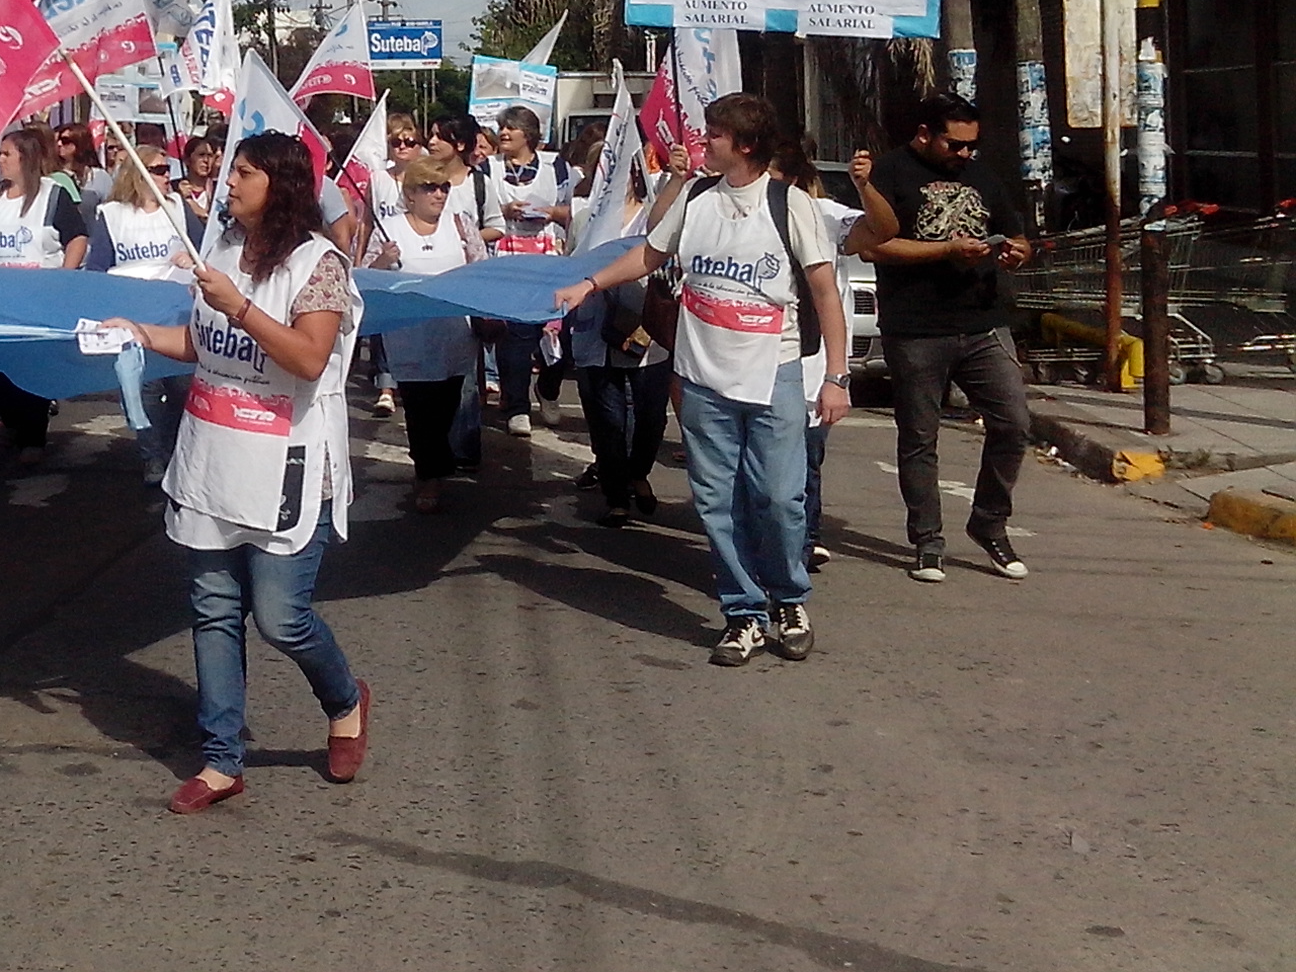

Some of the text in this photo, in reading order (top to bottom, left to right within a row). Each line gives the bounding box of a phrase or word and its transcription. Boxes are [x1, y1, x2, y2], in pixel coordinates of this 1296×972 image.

[685, 0, 748, 11] AUMENTO
[808, 3, 875, 14] AUMENTO
[684, 14, 749, 25] SALARIAL
[809, 18, 876, 29] SALARIAL
[371, 33, 421, 53] Suteba
[116, 241, 168, 261] Suteba
